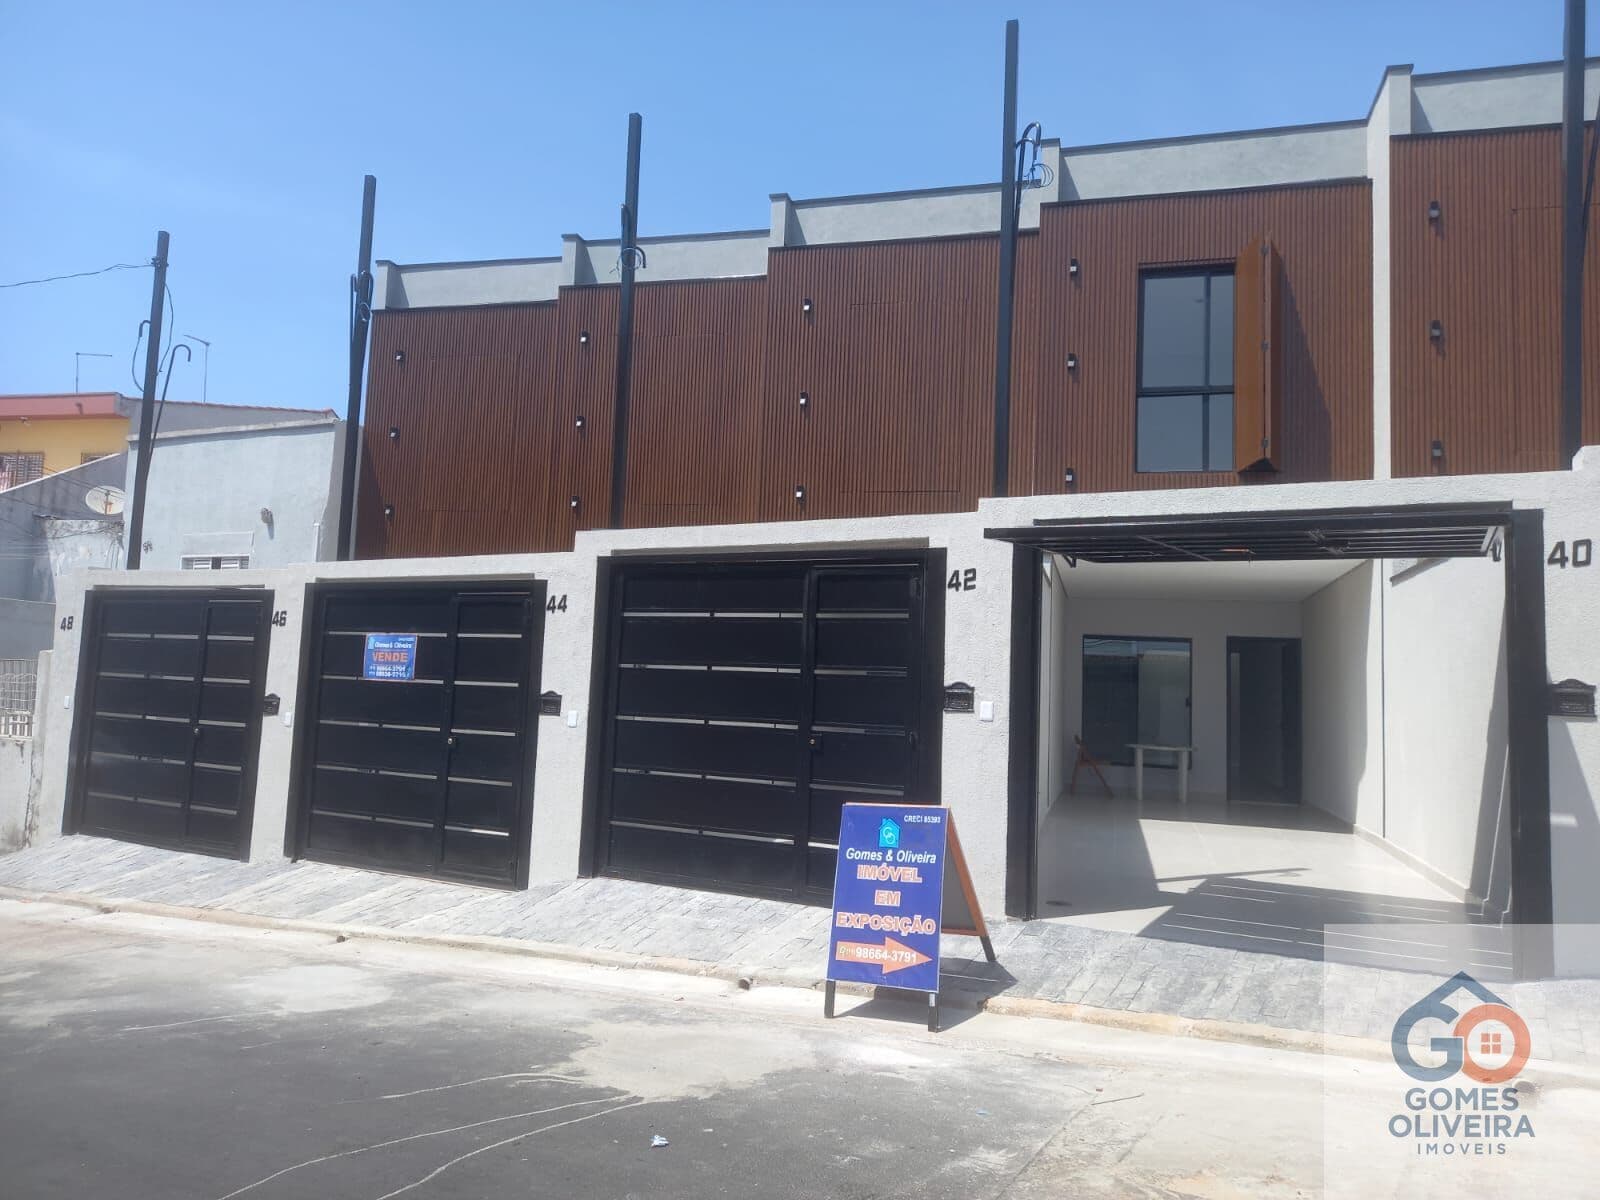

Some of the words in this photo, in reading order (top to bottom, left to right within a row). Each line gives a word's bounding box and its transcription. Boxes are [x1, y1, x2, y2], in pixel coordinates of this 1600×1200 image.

[1547, 538, 1592, 569] 40
[947, 567, 977, 592] 42
[546, 594, 568, 614] 44
[60, 615, 74, 631] 48
[272, 610, 288, 627] 46
[372, 651, 409, 663] VENDE
[903, 814, 923, 824] CRECI
[846, 847, 883, 861] Gomes
[885, 849, 894, 862] &
[896, 850, 937, 864] Oliveira
[856, 862, 923, 883] IMÓVEL
[874, 889, 901, 907] EM
[835, 911, 936, 936] EXPOSIÇÃO
